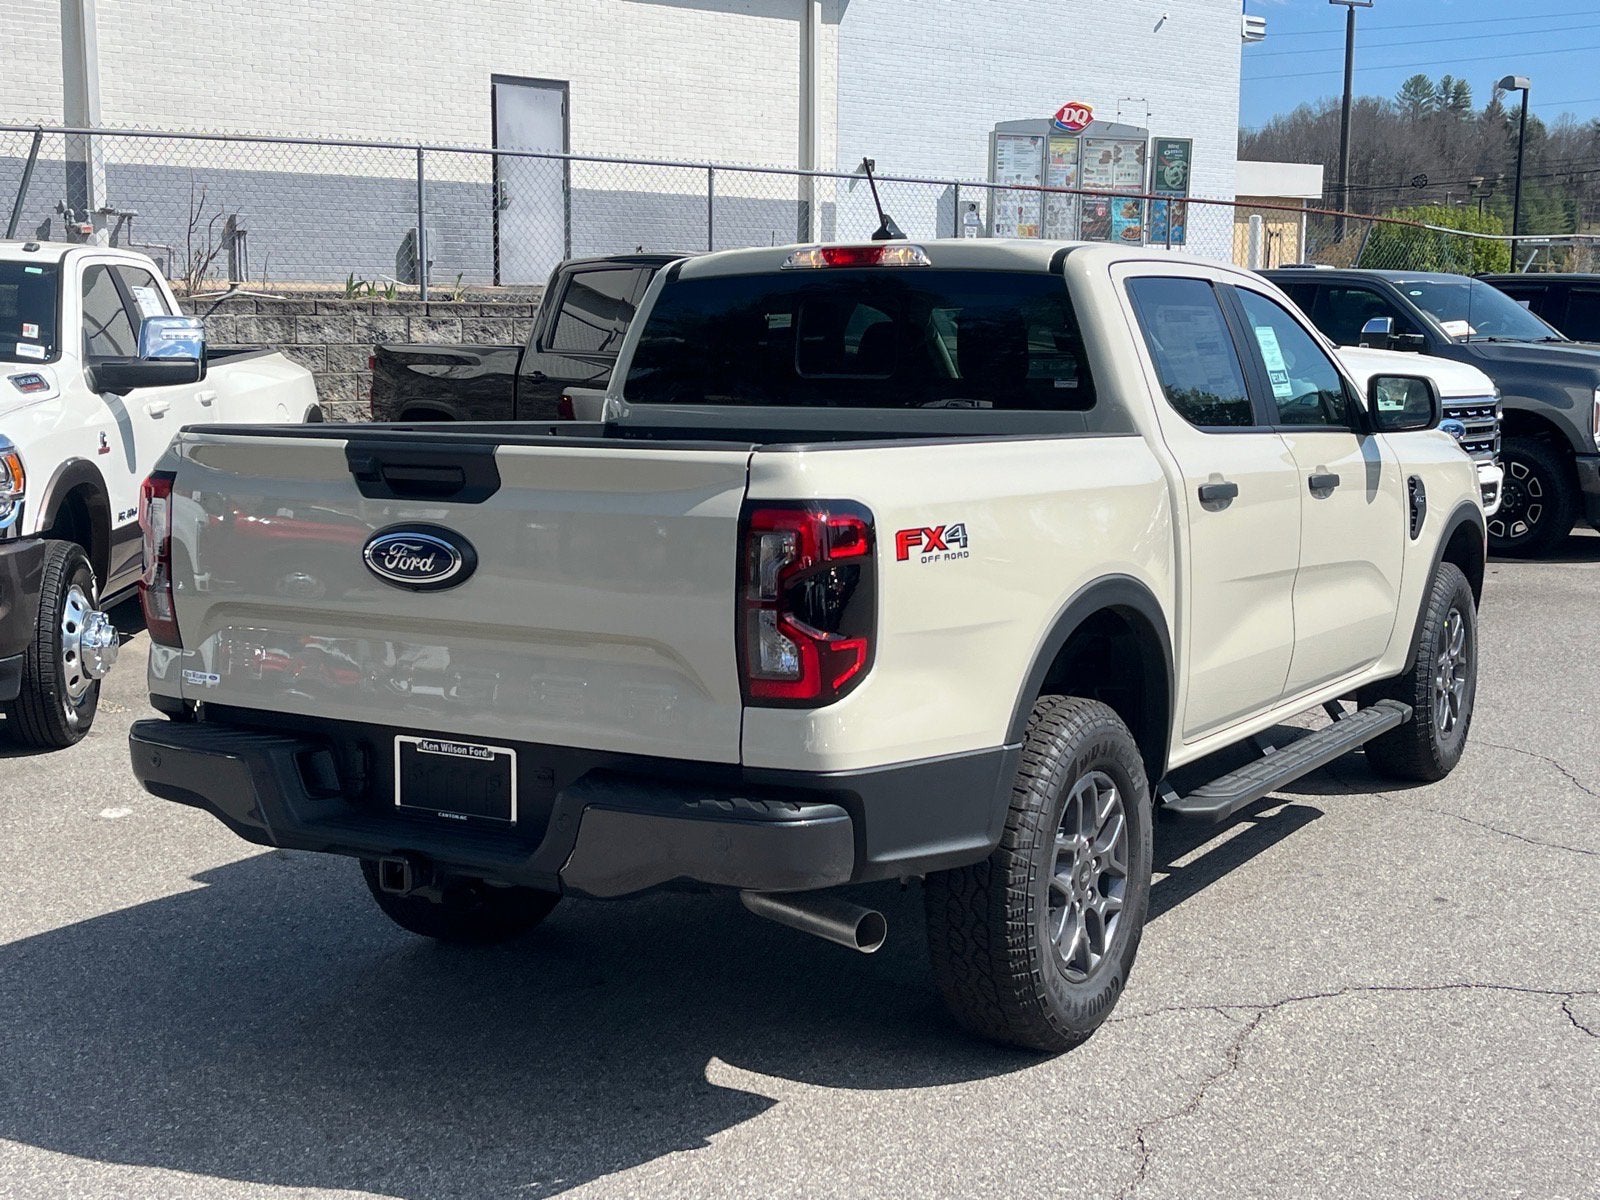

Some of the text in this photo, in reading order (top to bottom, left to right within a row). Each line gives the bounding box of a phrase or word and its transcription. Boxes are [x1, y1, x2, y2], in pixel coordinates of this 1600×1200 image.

[1061, 107, 1089, 126] DQ
[895, 522, 968, 561] FX4
[385, 542, 436, 571] Ford
[921, 551, 969, 564] OFF ROAD
[422, 741, 488, 757] Ken Wilson Ford
